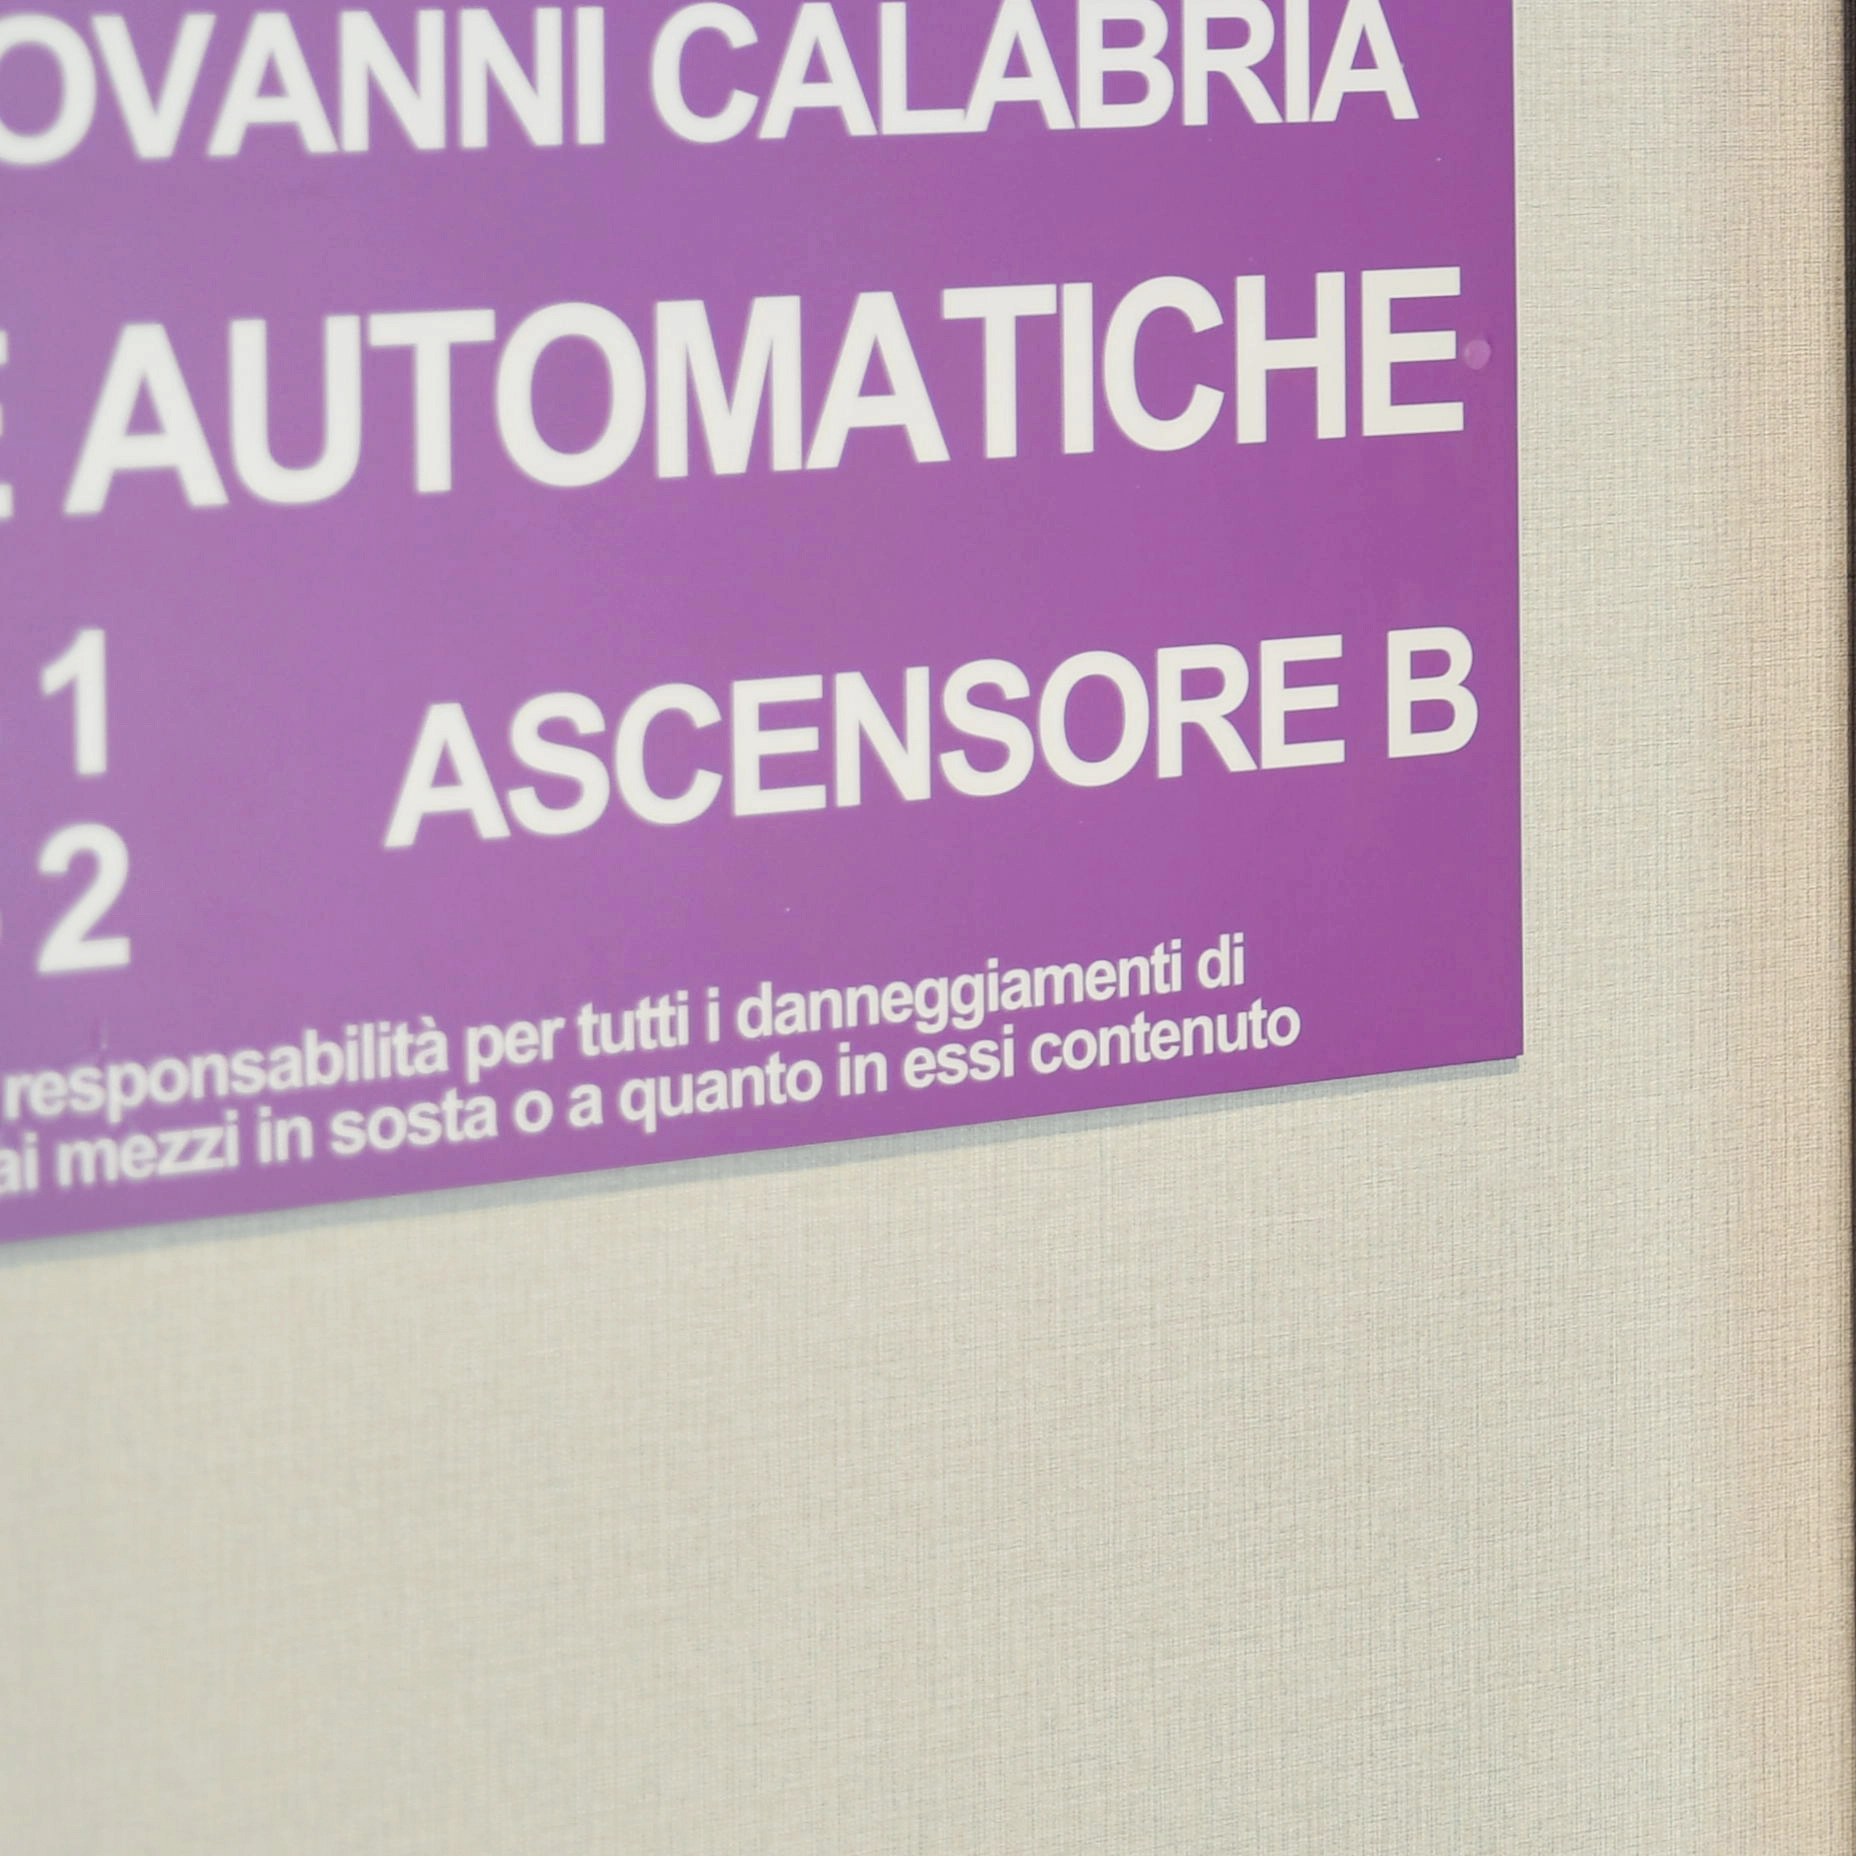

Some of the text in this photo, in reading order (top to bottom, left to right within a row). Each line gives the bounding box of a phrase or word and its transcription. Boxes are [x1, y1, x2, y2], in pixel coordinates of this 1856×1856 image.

[0, 6, 605, 167] OVANNI
[64, 266, 1464, 515] AUTOMATICHE
[41, 628, 108, 777] 1
[384, 626, 1478, 849] ASCENSORE B
[36, 822, 131, 975] 2
[3, 932, 1244, 1124] responsabilità per tutti i danneggiamenti di
[57, 1109, 239, 1188] mezzi
[257, 1106, 313, 1165] in
[329, 1088, 499, 1156] sosta
[512, 1089, 554, 1134] o
[567, 1083, 604, 1128] a
[618, 1051, 823, 1134] quanto
[838, 1041, 888, 1097] in
[903, 1023, 1014, 1089] essi
[1030, 998, 1301, 1074] contenuto
